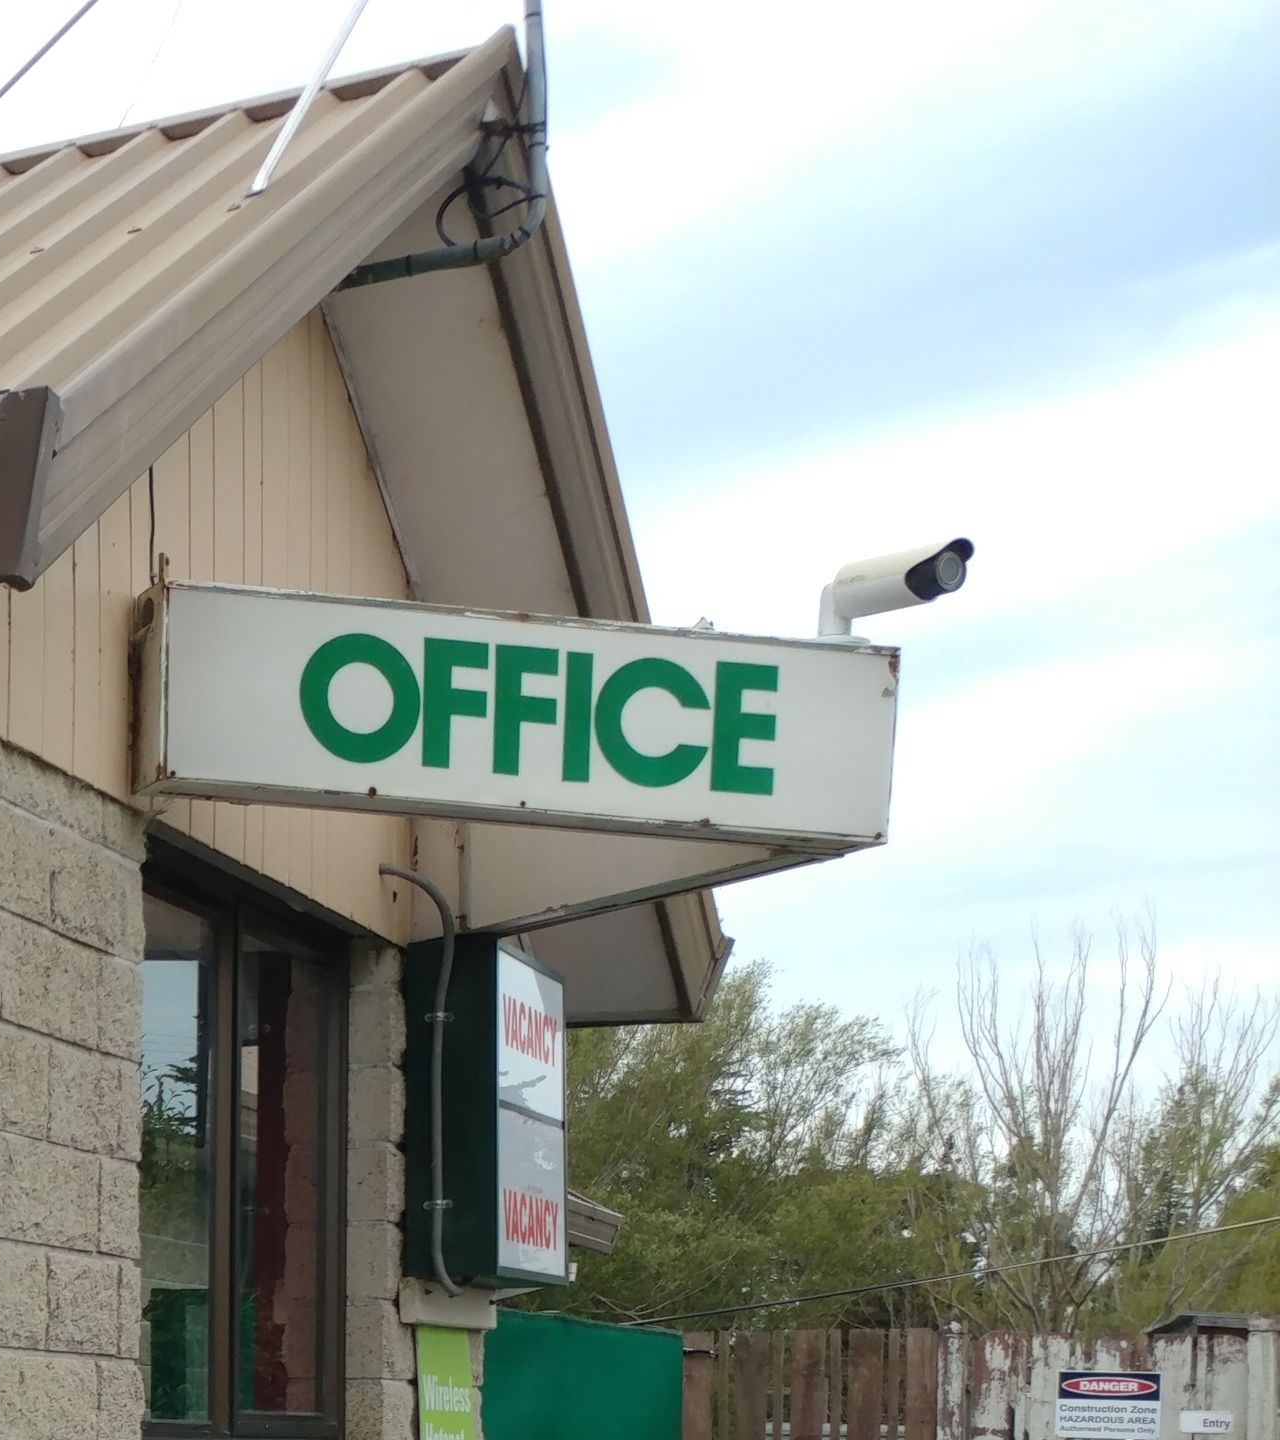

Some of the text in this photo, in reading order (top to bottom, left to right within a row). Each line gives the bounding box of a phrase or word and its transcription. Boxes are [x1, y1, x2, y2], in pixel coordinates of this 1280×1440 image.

[300, 633, 779, 796] OFFICE
[503, 993, 558, 1067] VACANCY
[503, 1188, 559, 1251] VACANCY
[1079, 1381, 1139, 1392] DANGER
[423, 1374, 470, 1413] Wireless
[1059, 1404, 1157, 1414] Construction Zone
[1059, 1415, 1157, 1425] HAZARDOUS AREA
[1202, 1418, 1231, 1430] Entry
[1137, 1427, 1155, 1435] Only
